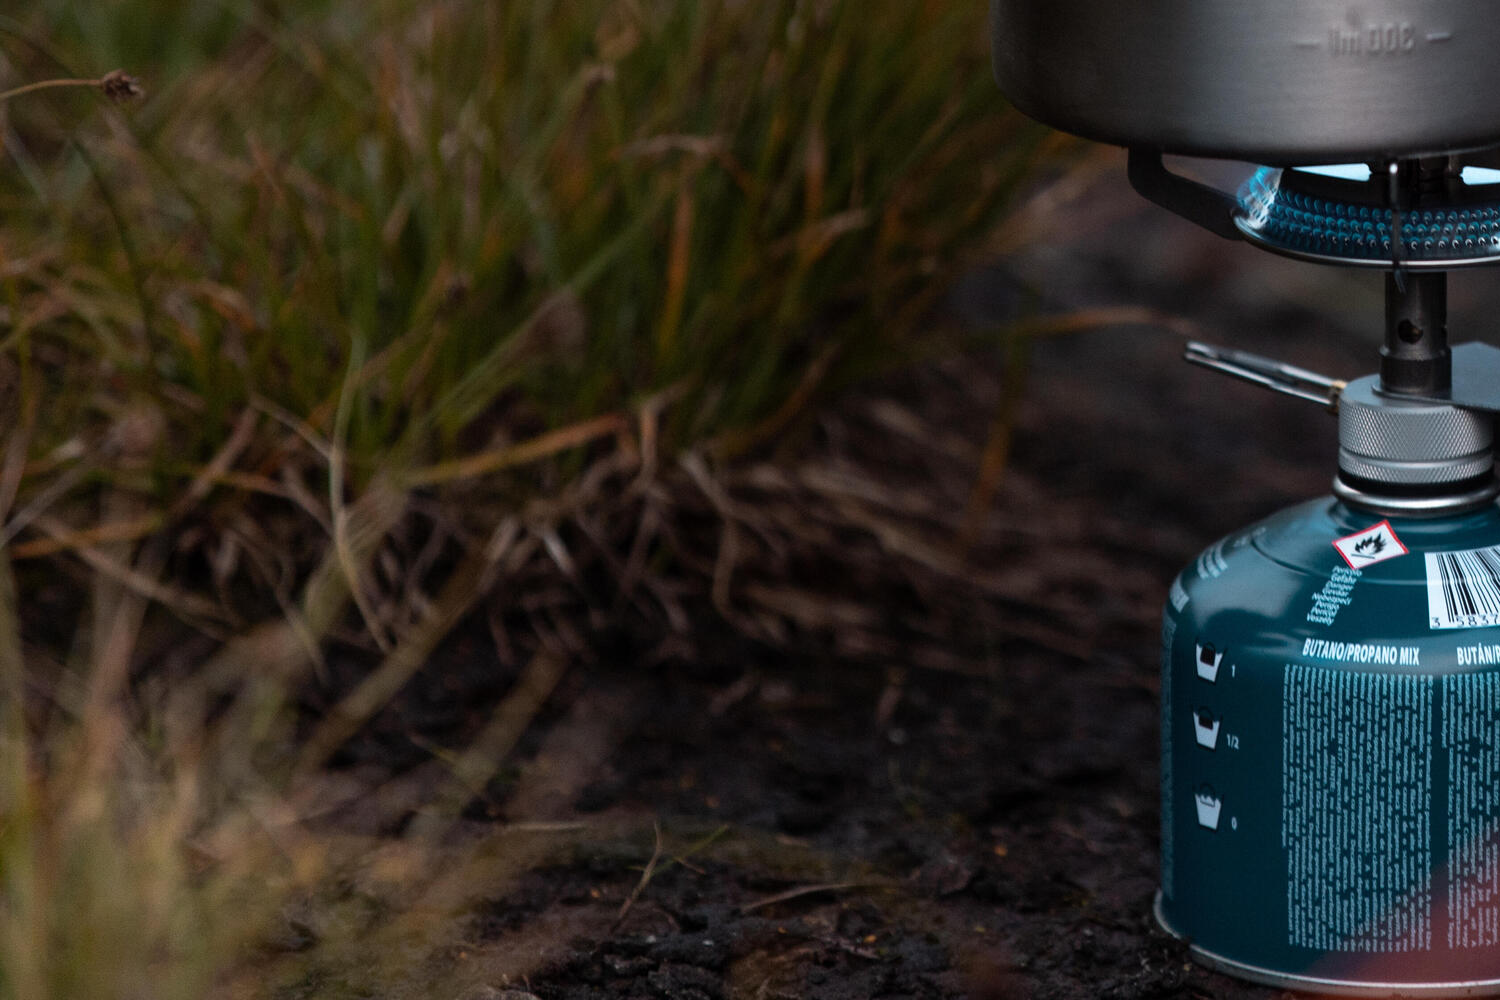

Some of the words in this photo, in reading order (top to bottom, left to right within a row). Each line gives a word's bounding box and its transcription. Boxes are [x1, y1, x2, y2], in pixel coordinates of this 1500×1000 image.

[1431, 616, 1441, 628] 3
[1302, 638, 1398, 665] BUTANO/PROPANO
[1399, 646, 1420, 666] MIX
[1231, 664, 1236, 678] 1
[1226, 733, 1240, 750] 1/2
